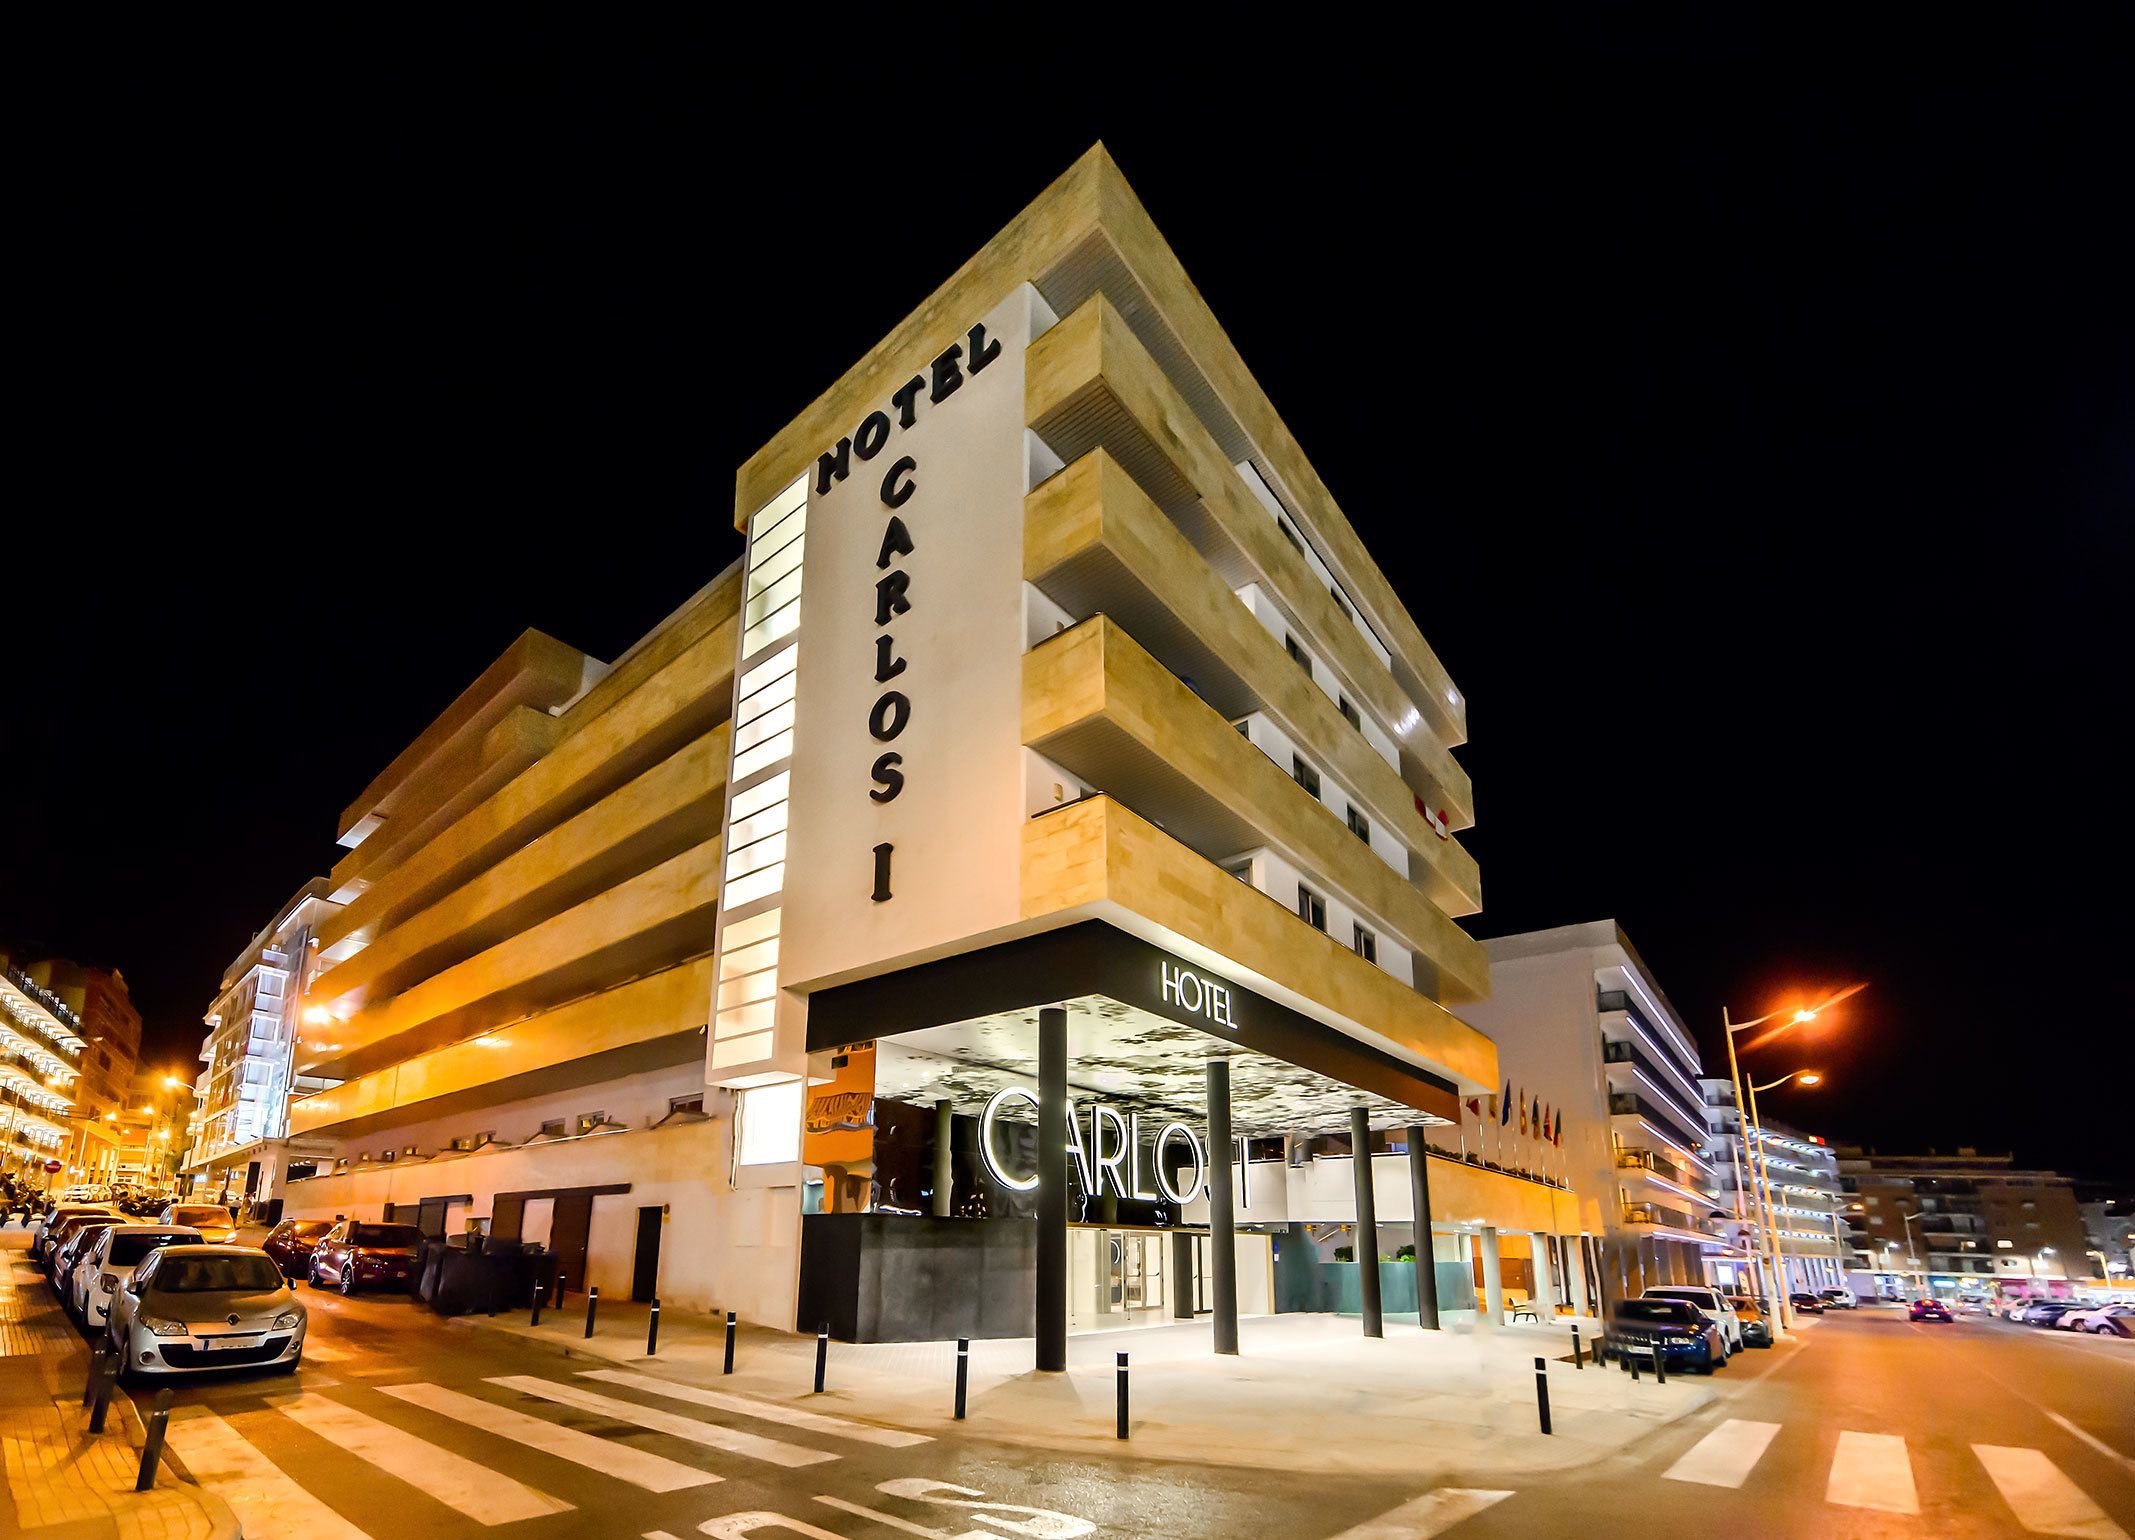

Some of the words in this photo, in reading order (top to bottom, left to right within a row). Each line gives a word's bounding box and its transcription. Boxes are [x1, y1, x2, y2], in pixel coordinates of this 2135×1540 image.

[816, 322, 1002, 496] HOTEL
[868, 455, 917, 804] CARLOS
[871, 842, 895, 902] I
[1161, 960, 1238, 1029] HOTEL
[977, 1086, 1210, 1206] CARLO
